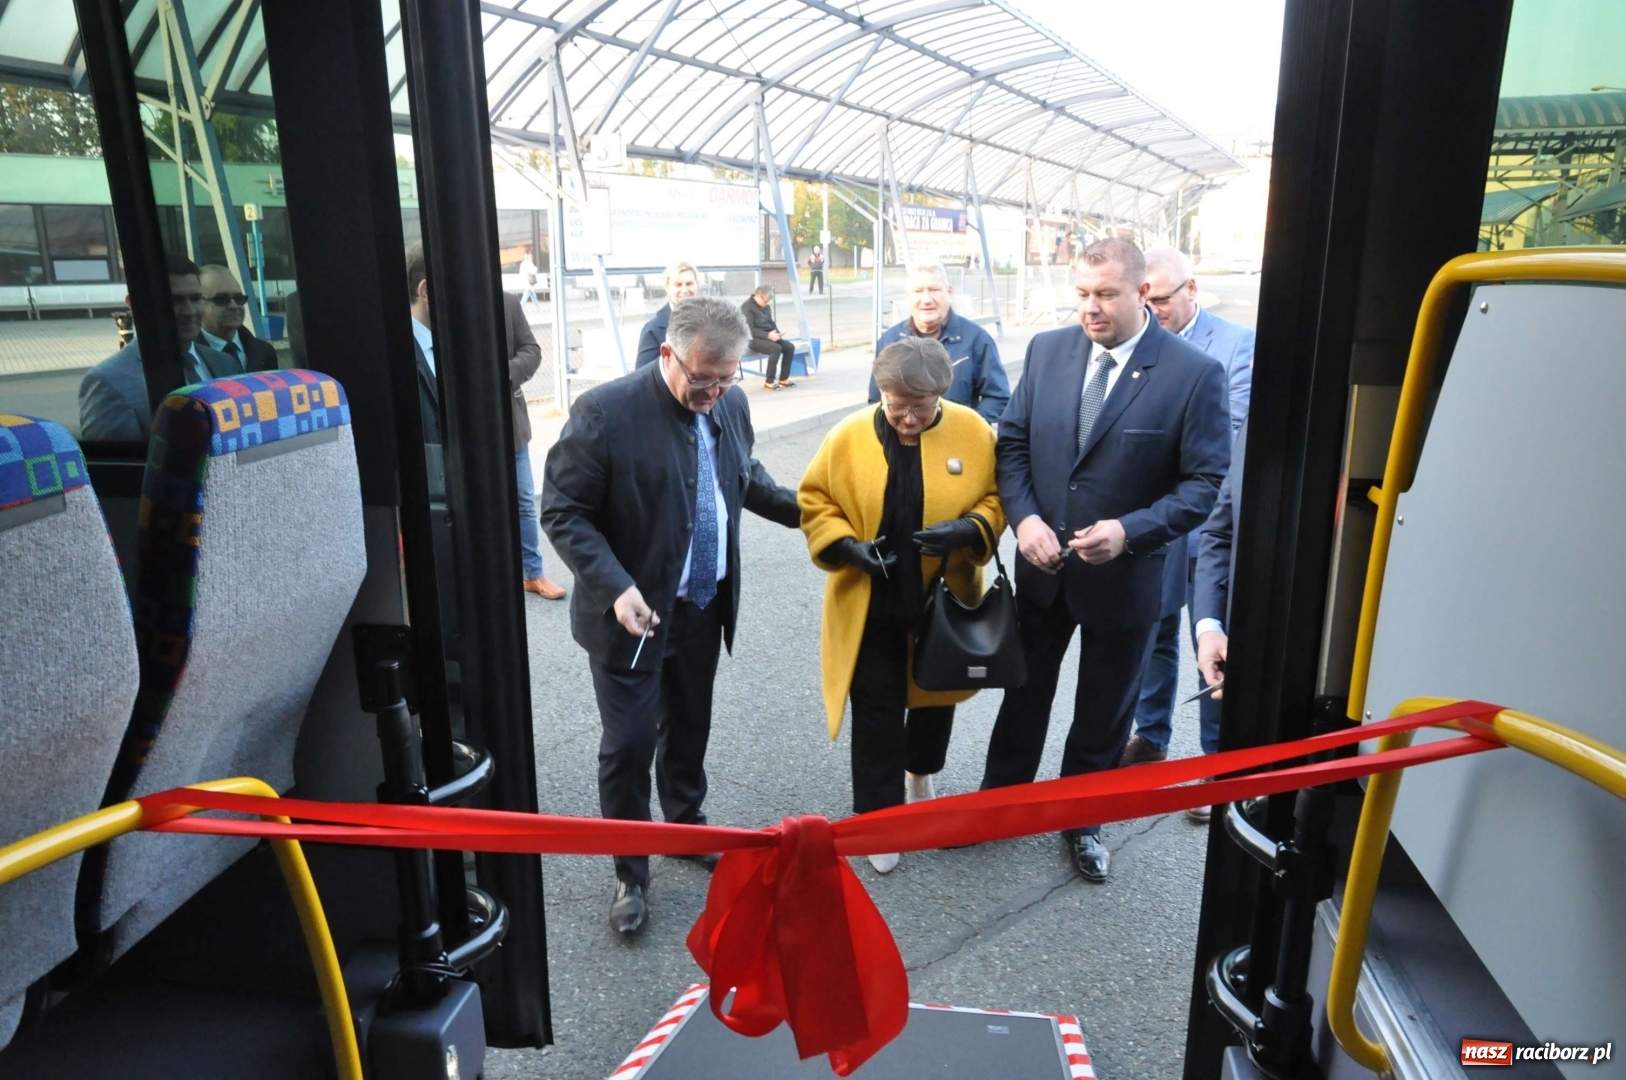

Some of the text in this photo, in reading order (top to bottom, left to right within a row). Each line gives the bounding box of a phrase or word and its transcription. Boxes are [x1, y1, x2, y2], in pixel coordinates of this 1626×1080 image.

[596, 141, 609, 162] 3
[709, 186, 758, 206] DARMO!
[246, 206, 254, 219] 2
[1049, 205, 1056, 216] 4
